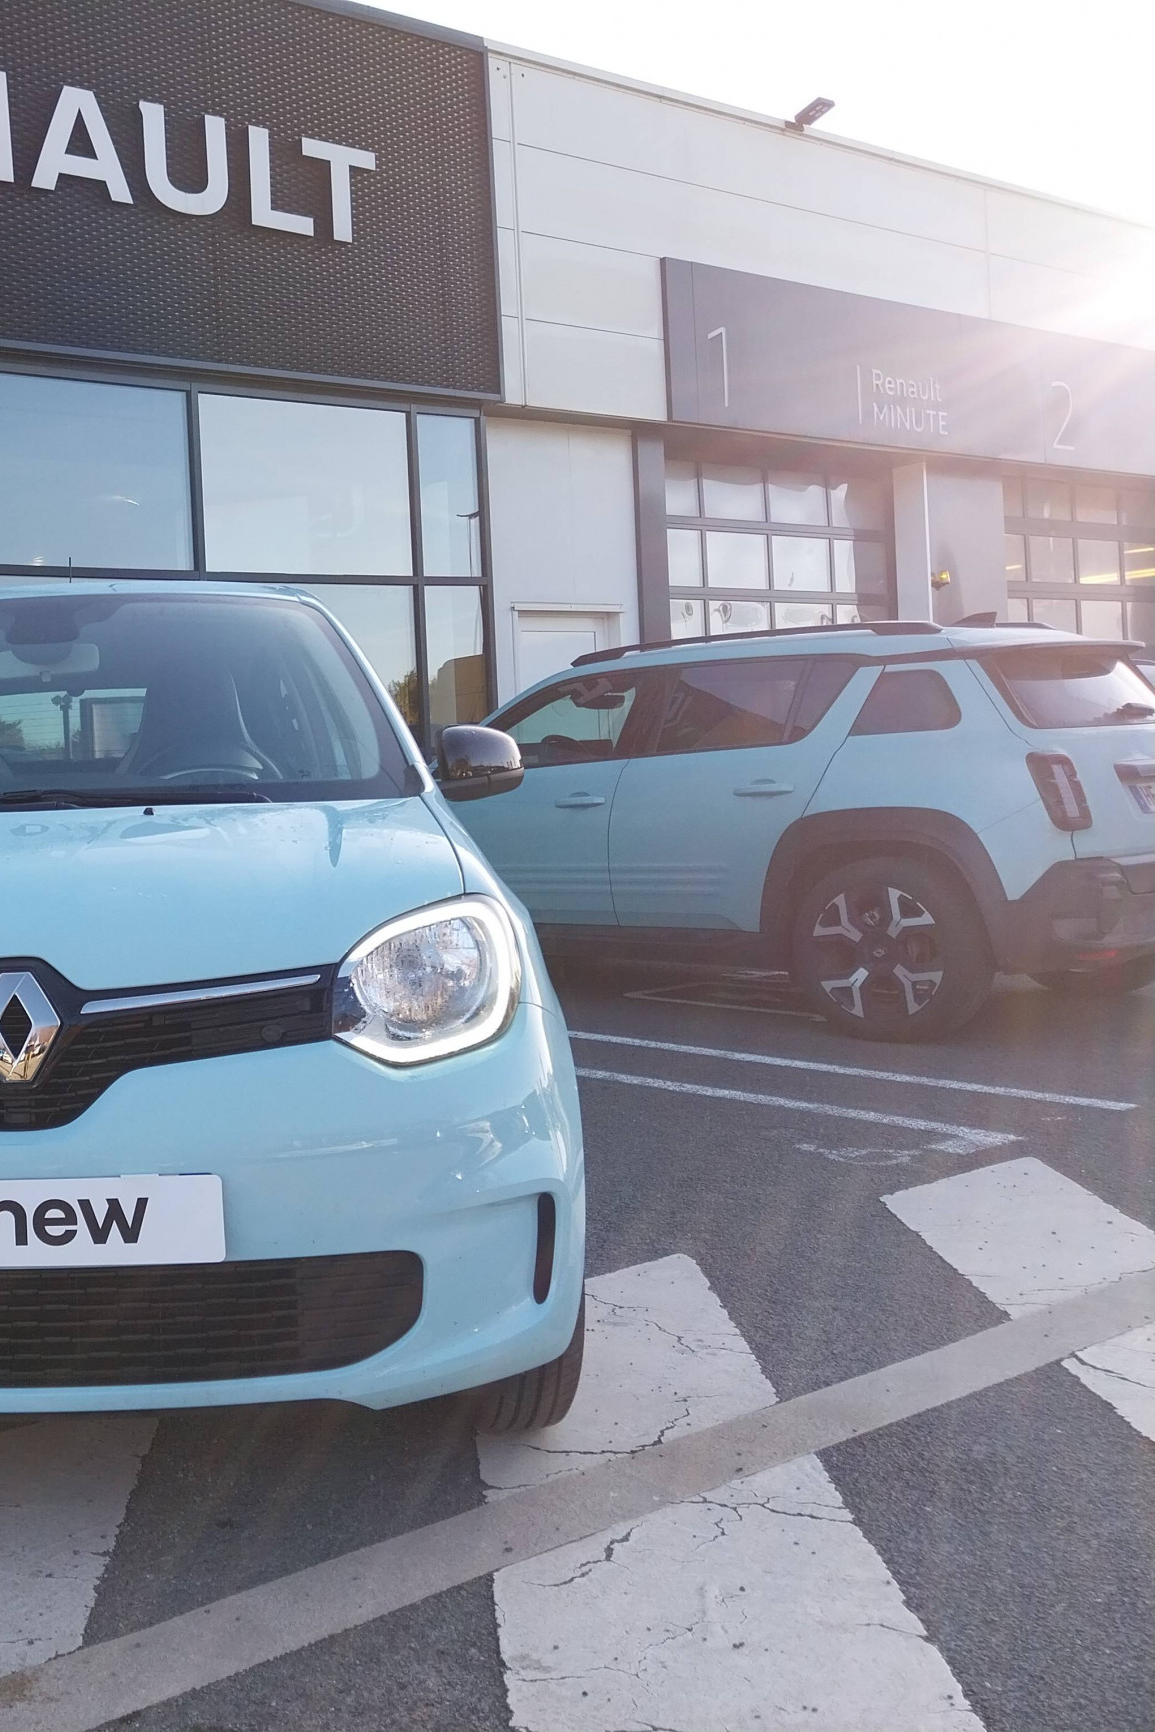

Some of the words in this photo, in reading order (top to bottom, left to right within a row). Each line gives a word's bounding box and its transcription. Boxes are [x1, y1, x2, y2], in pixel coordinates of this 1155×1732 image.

[707, 326, 729, 408] 1
[871, 367, 943, 403] Renault
[873, 400, 950, 436] MINUTE
[1050, 380, 1076, 451] 2
